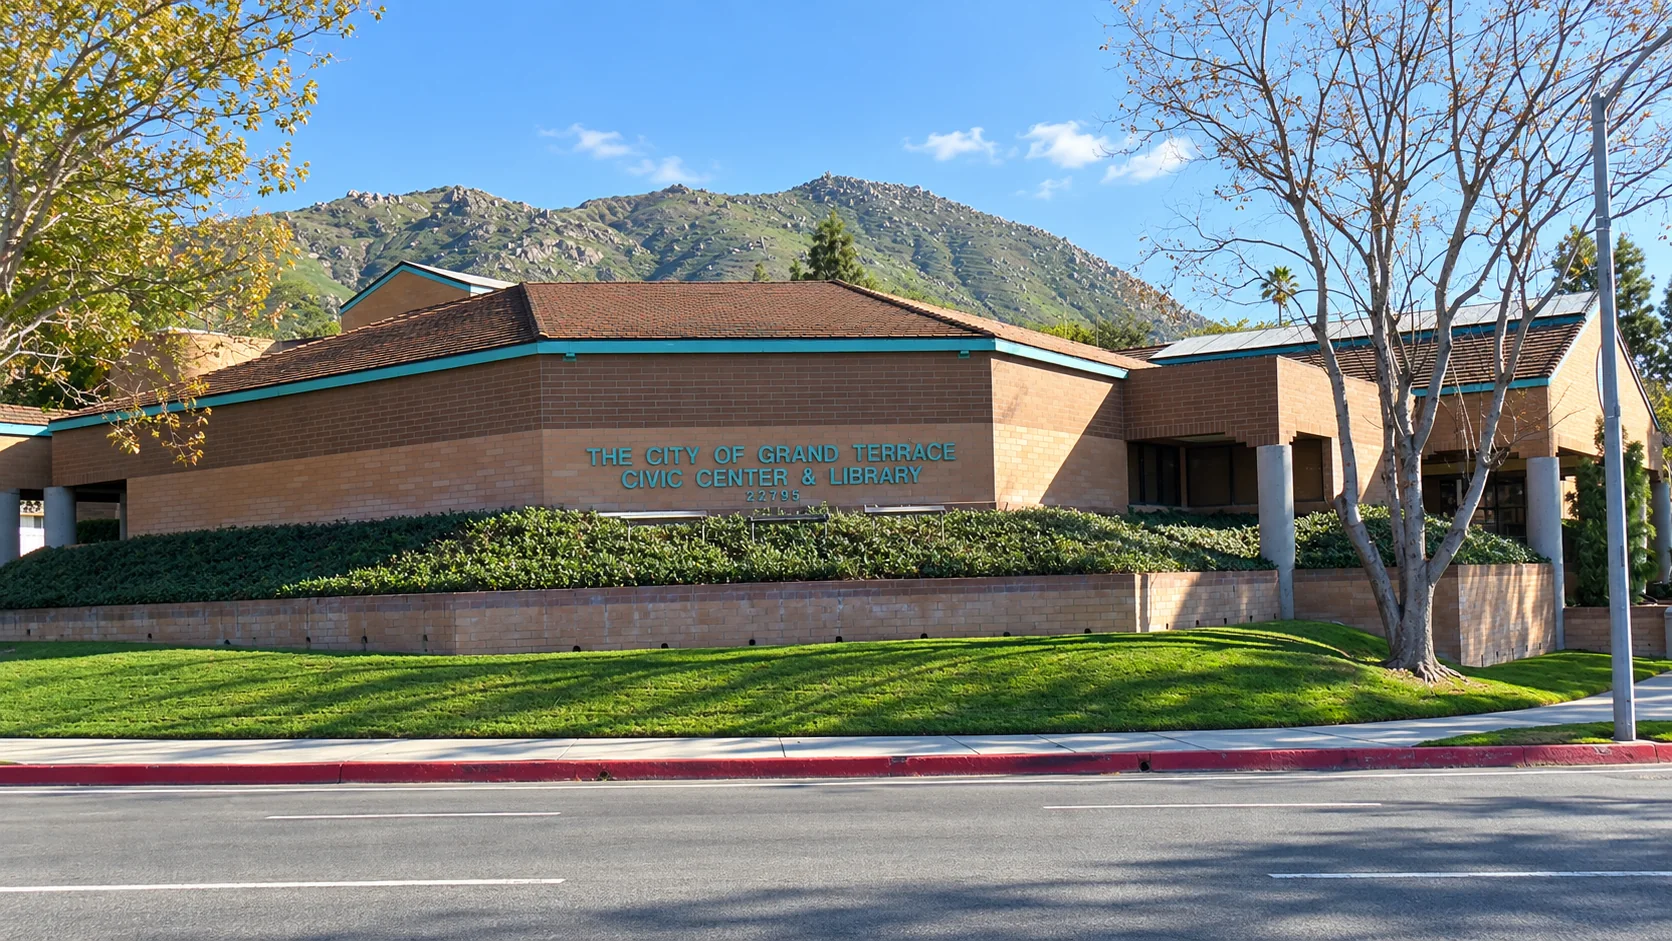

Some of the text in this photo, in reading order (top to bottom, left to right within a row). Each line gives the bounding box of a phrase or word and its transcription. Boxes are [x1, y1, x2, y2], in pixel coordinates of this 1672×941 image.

[586, 442, 956, 466] THE CITY OF GRAND TERRACE
[621, 465, 922, 489] CIVIC CENTER & LIBRARY
[746, 489, 800, 502] 22795
